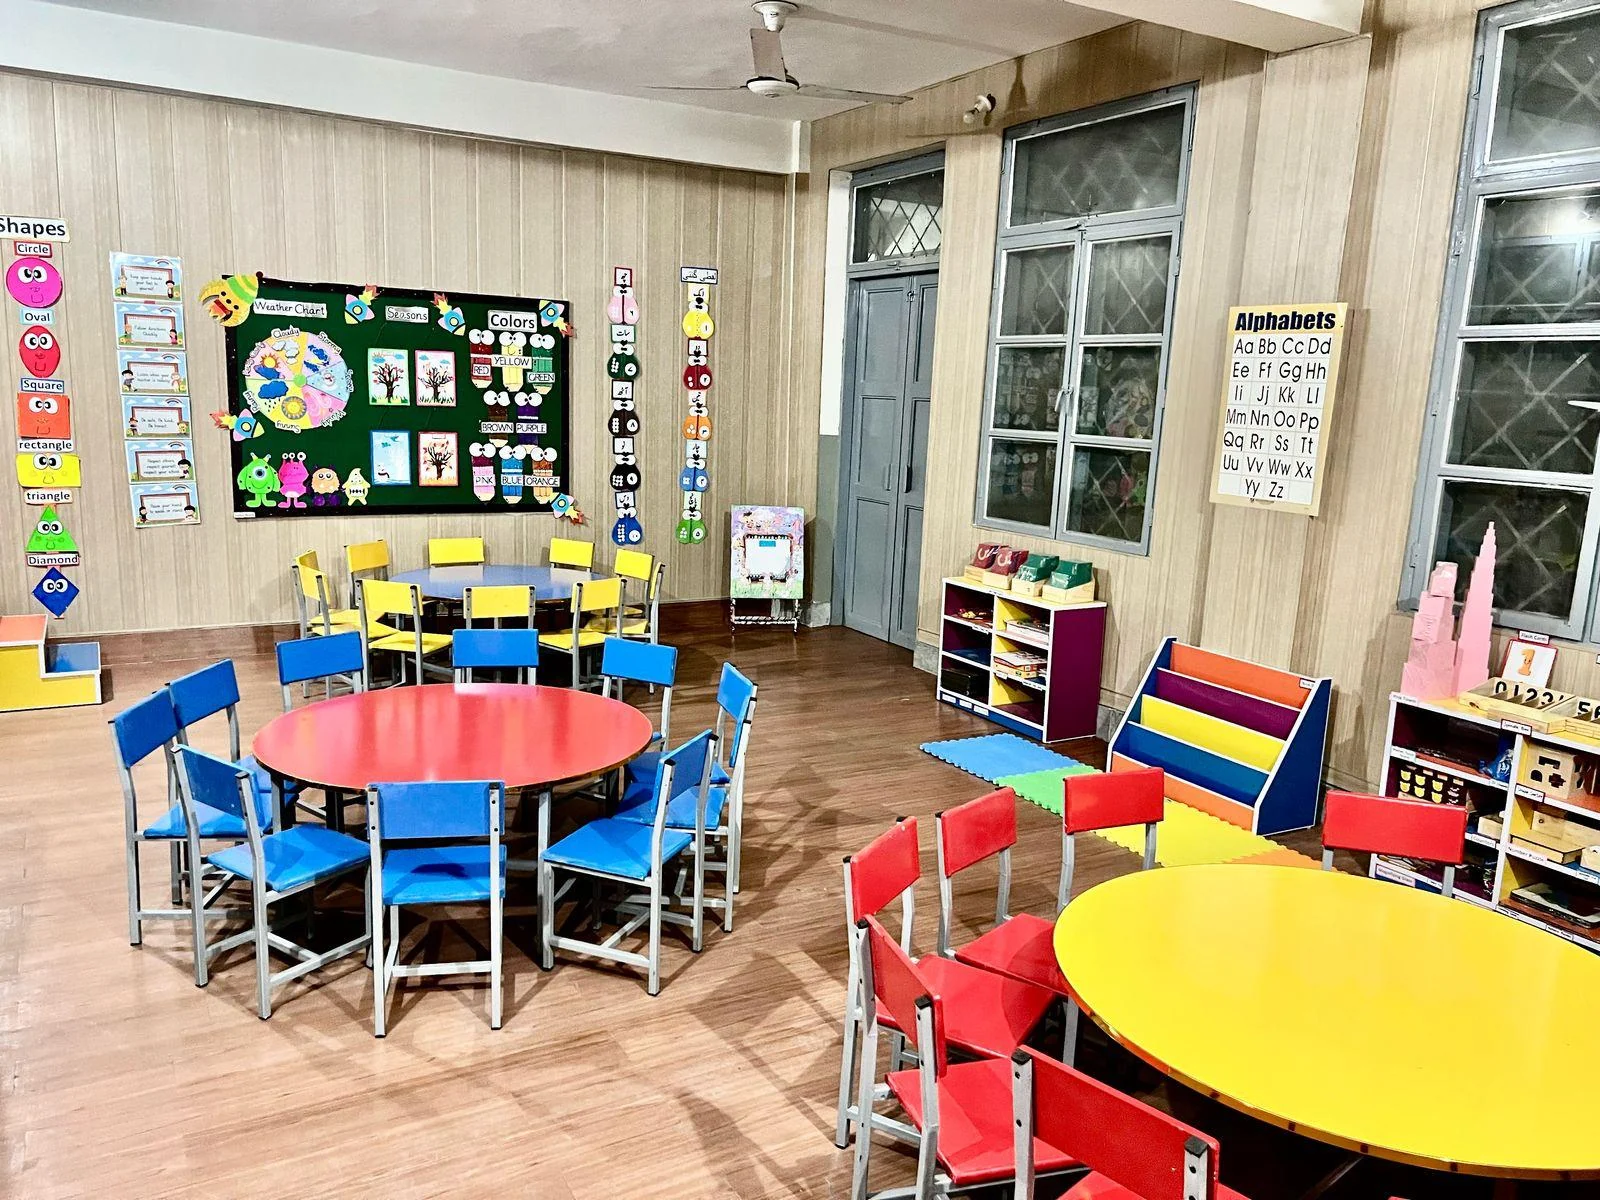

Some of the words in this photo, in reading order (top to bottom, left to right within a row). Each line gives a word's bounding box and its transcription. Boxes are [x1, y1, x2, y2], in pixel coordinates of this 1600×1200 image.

[0, 218, 66, 238] Shapes
[17, 244, 49, 254] Circle
[255, 302, 294, 312] Weather
[294, 304, 325, 316] Chart
[388, 307, 428, 320] Seasons
[24, 312, 50, 322] Oval
[490, 314, 535, 329] Colors
[1234, 310, 1336, 332] Alphabets
[273, 328, 299, 339] Cloudy
[1234, 338, 1254, 354] Aa
[1258, 338, 1277, 354] Bb
[1282, 337, 1304, 354] Cc
[1308, 337, 1332, 354] Dd
[494, 356, 530, 366] YELLOW
[474, 366, 490, 375] RED
[1232, 362, 1250, 378] Ee
[1258, 362, 1272, 378] Ff
[1279, 362, 1302, 382] Gg
[1306, 362, 1326, 380] Hh
[528, 374, 554, 382] GREEN
[24, 380, 62, 391] Square
[1234, 385, 1243, 400] Ii
[1256, 386, 1270, 406] Jj
[1278, 386, 1296, 403] Kk
[1306, 387, 1320, 404] Ll
[1226, 408, 1246, 424] Mm
[1250, 410, 1270, 426] Nn
[1274, 410, 1296, 428] Oo
[1300, 412, 1319, 434] Pp
[482, 424, 512, 432] BROWN
[516, 424, 546, 432] PURPLE
[19, 440, 72, 451] rectangle
[1224, 431, 1244, 451] Qq
[1250, 433, 1264, 450] Rr
[1274, 434, 1288, 452] Ss
[1301, 436, 1314, 454] Tt
[1223, 454, 1239, 471] Uu
[1246, 456, 1264, 473] Vv
[1268, 458, 1291, 476] Ww
[1294, 461, 1312, 479] Xx
[502, 476, 522, 484] BLUE
[526, 476, 558, 486] ORANGE
[1245, 478, 1260, 498] Yy
[1268, 482, 1284, 498] Zz
[26, 492, 70, 502] triangle
[29, 555, 78, 564] Diamond
[1518, 648, 1536, 676] 1
[1525, 688, 1538, 702] 2
[1578, 701, 1590, 715] 5
